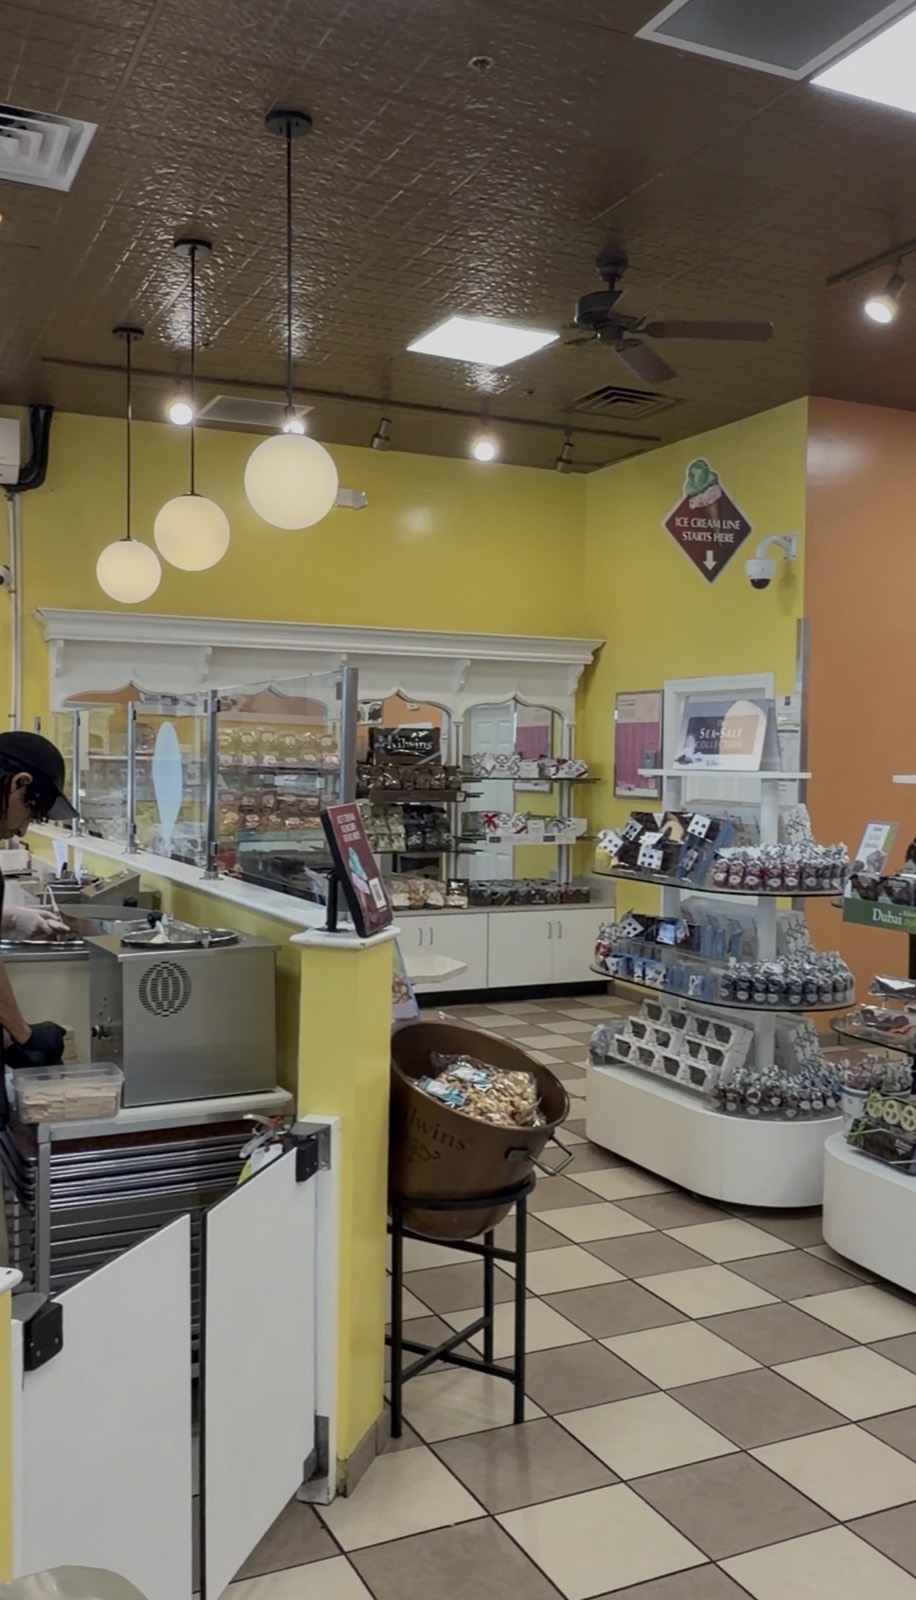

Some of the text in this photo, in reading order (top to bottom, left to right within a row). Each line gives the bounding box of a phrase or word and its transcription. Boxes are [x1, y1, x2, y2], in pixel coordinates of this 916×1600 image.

[675, 516, 740, 530] ICE CREAM LINE
[682, 531, 735, 543] STARTS HERE
[873, 908, 902, 925] Dubai
